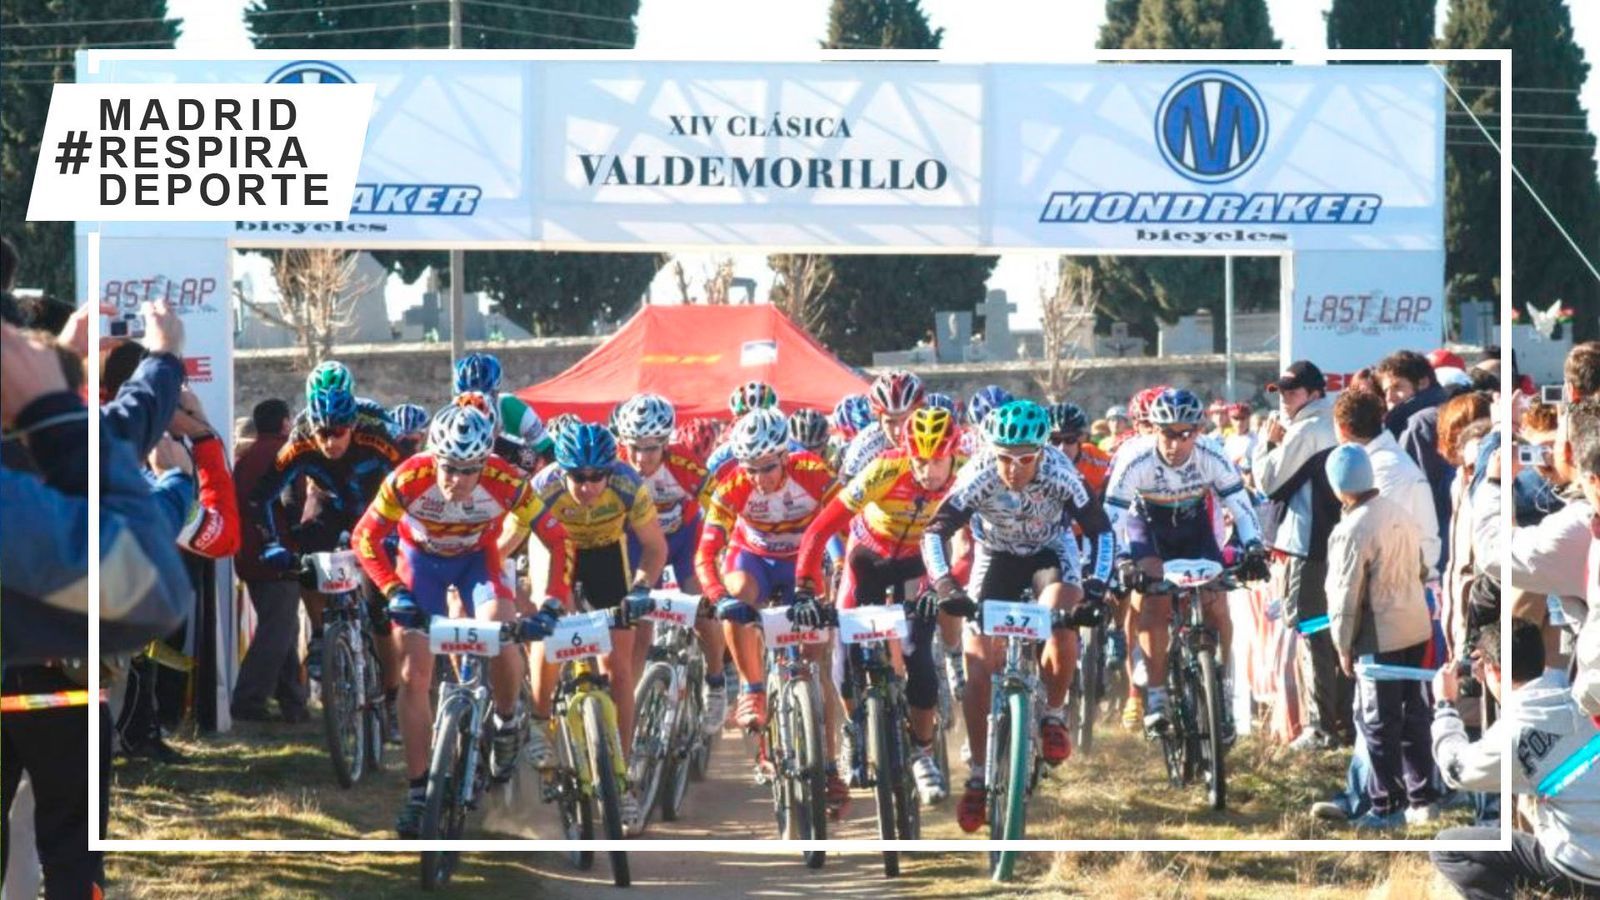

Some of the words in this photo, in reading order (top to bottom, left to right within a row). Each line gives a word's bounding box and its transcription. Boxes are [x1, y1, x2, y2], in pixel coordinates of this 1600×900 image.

[669, 115, 719, 136] XIV
[727, 110, 851, 139] CLÁSICA
[580, 154, 948, 191] VALDEMORILLO
[351, 184, 482, 216] AKER
[1039, 192, 1382, 224] MONDRAKER
[1136, 229, 1288, 243] bicycles
[104, 280, 156, 309] AST
[1303, 295, 1373, 323] LAST
[1379, 296, 1432, 323] LAP
[453, 627, 479, 643] 15
[1005, 615, 1031, 628] 37
[571, 632, 583, 647] 6
